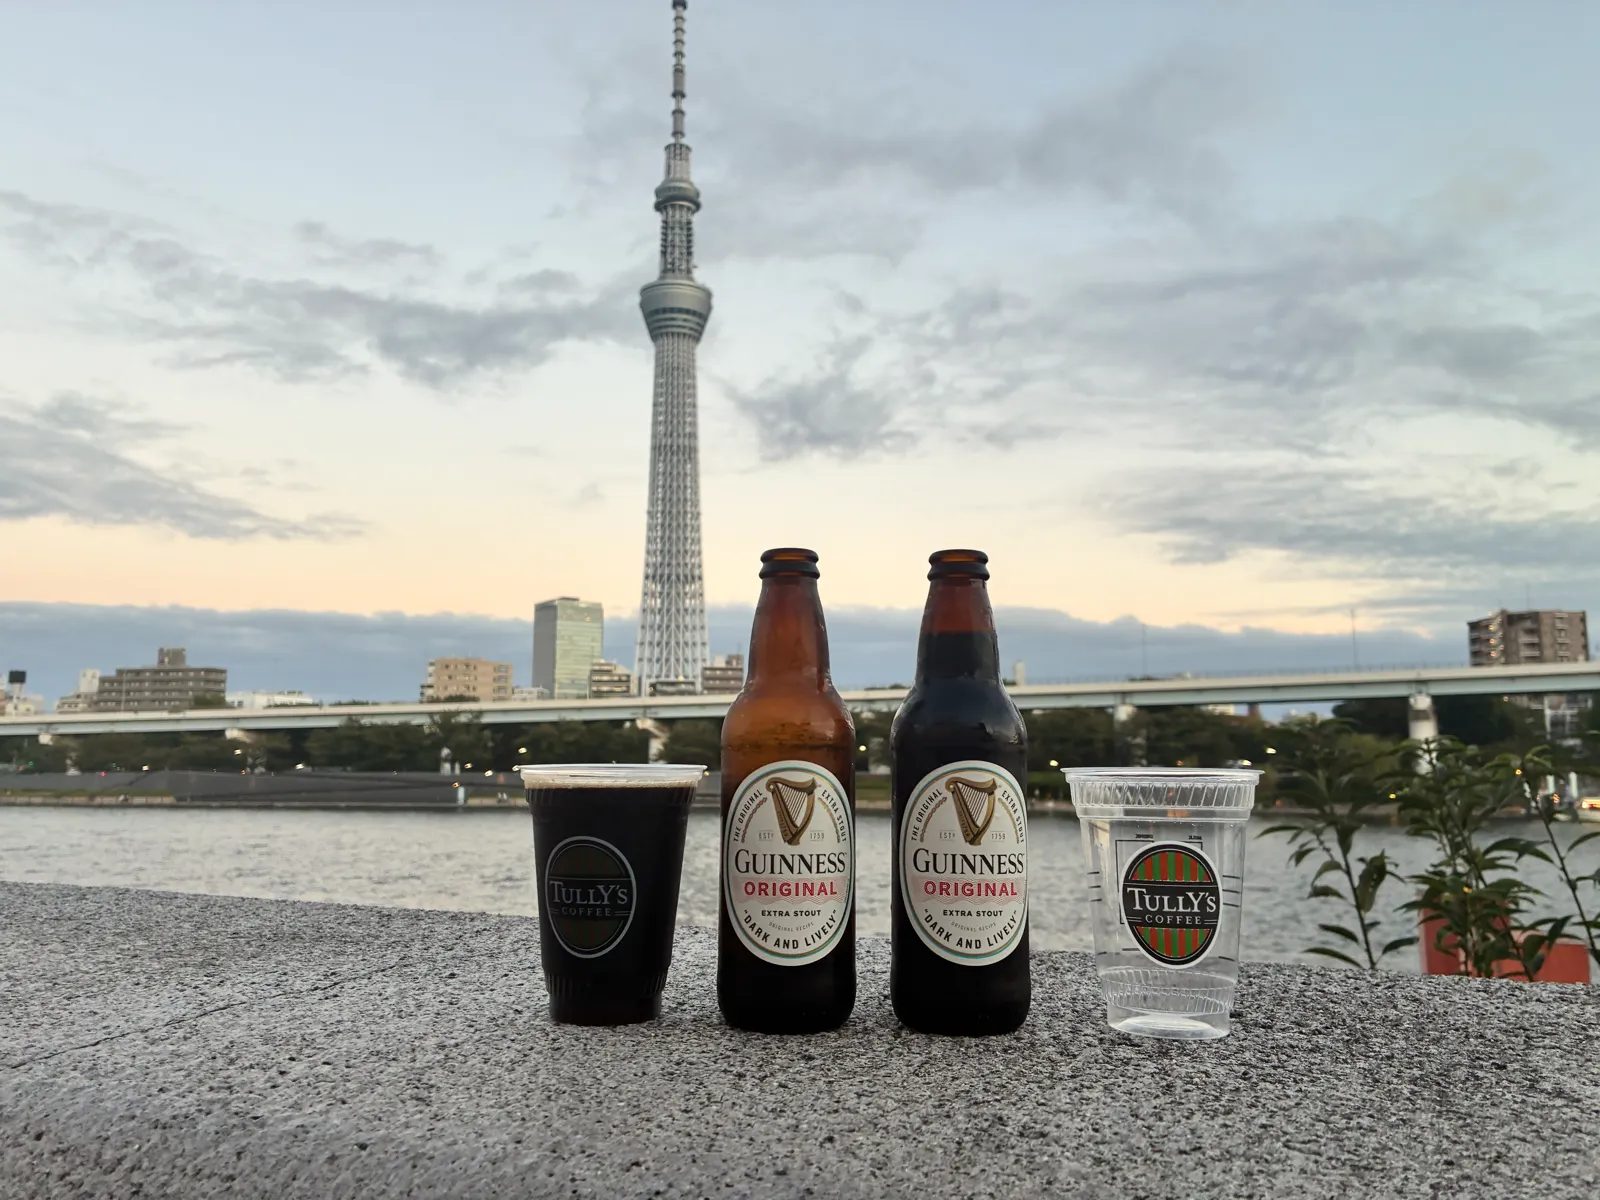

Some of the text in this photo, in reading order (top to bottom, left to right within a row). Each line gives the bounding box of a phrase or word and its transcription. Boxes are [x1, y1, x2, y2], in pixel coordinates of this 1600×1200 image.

[1001, 790, 1018, 814] EXTRA
[733, 789, 763, 842] THE ORIGINAL
[821, 789, 847, 842] EXTRA STOUT
[911, 788, 943, 841] THE ORIGINAL
[734, 849, 846, 875] GUINNESS
[912, 848, 1024, 875] GUINNESS
[549, 880, 628, 905] TULLY'S
[744, 881, 838, 897] ORIGINAL
[923, 880, 1018, 897] ORIGINAL
[1126, 887, 1217, 913] TULLY'S
[561, 906, 612, 917] COFFEE
[761, 909, 821, 917] EXTRA STOUT
[942, 909, 973, 917] EXTRA
[1145, 914, 1202, 925] COFFEE
[773, 937, 799, 950] AND
[956, 937, 982, 950] AND
